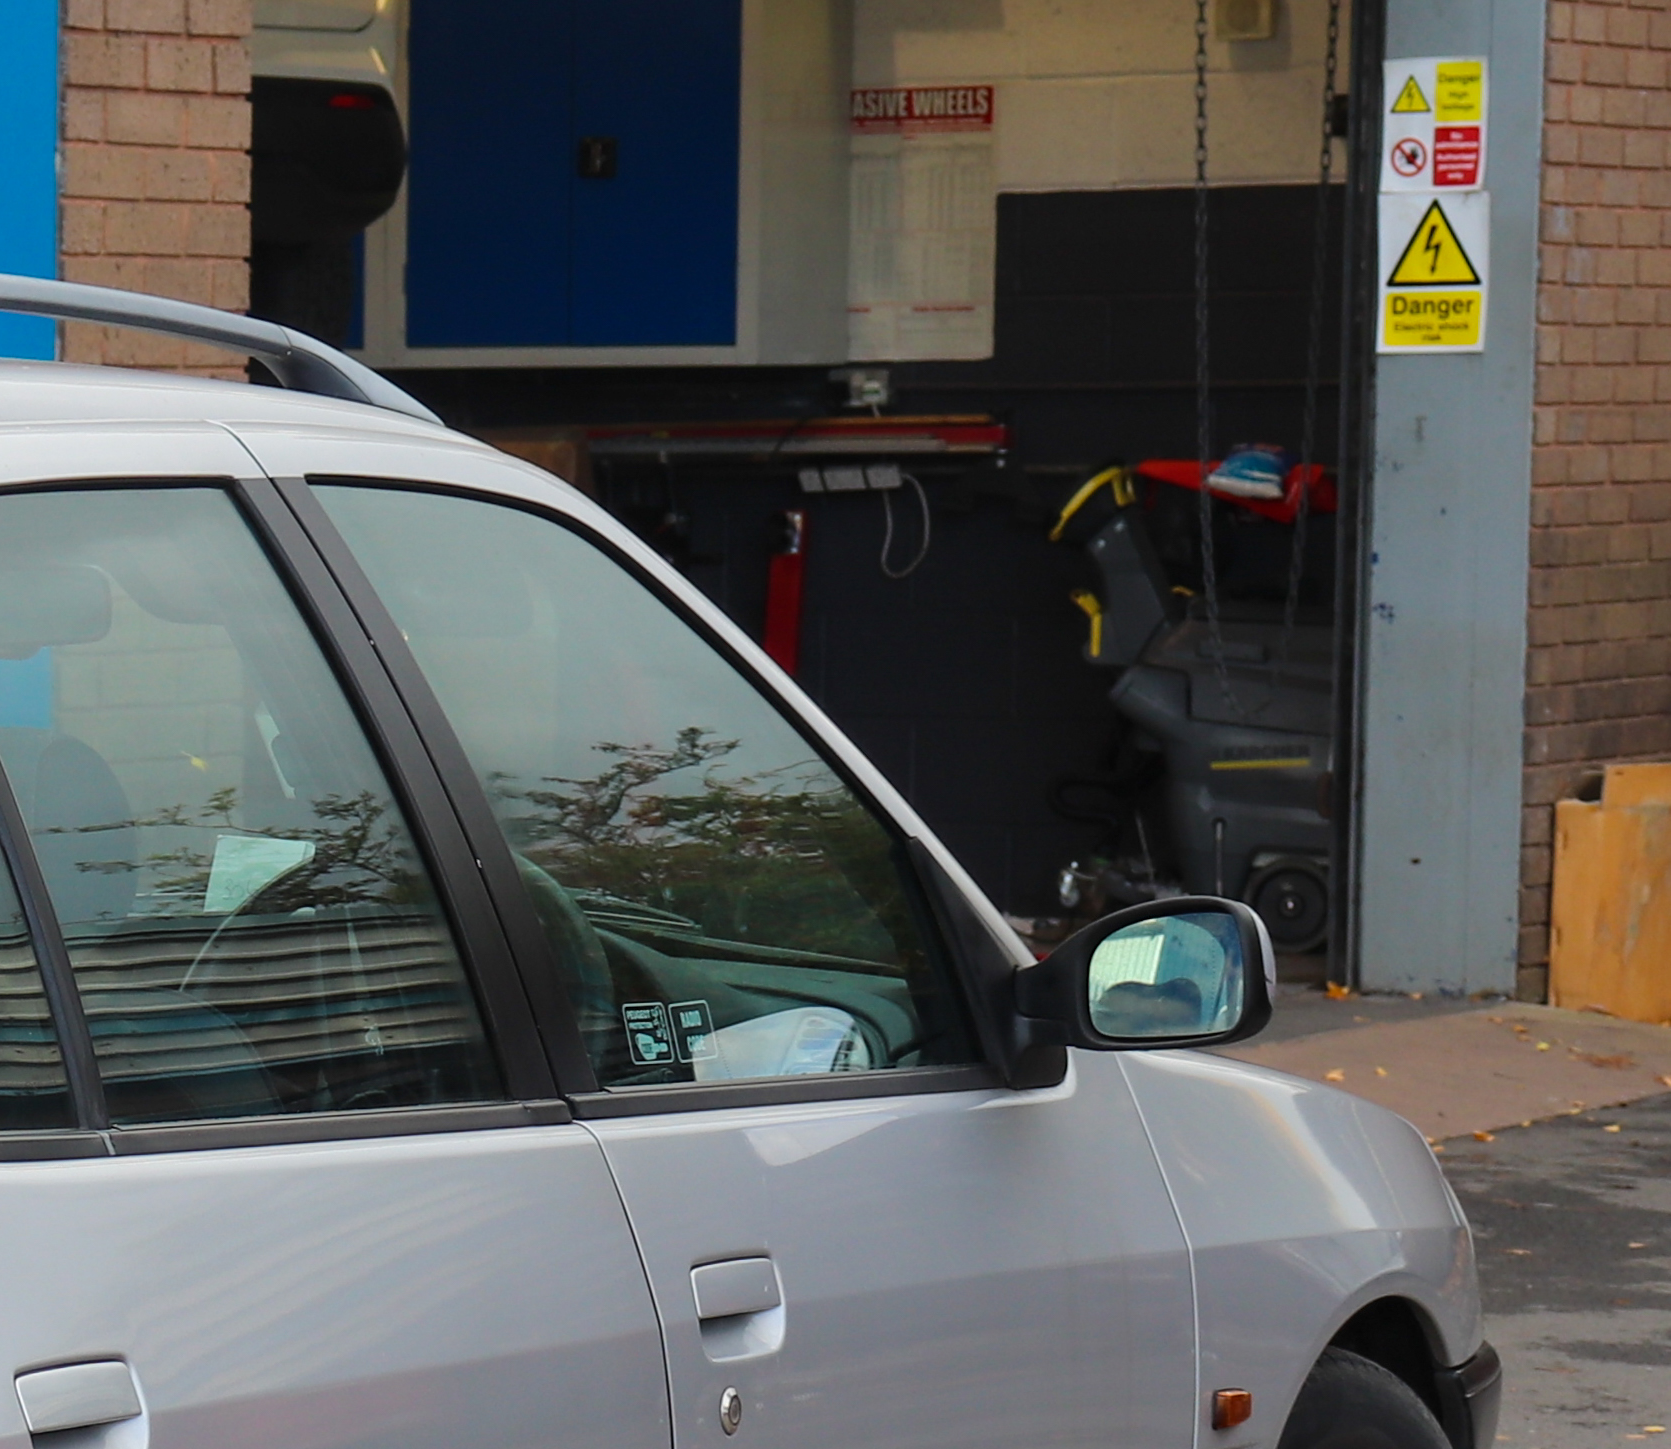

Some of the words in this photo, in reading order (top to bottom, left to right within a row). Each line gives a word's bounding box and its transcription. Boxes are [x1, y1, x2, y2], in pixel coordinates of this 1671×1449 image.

[1438, 73, 1480, 85] Danger
[911, 87, 990, 116] WHEELS
[1392, 296, 1475, 319] Danger
